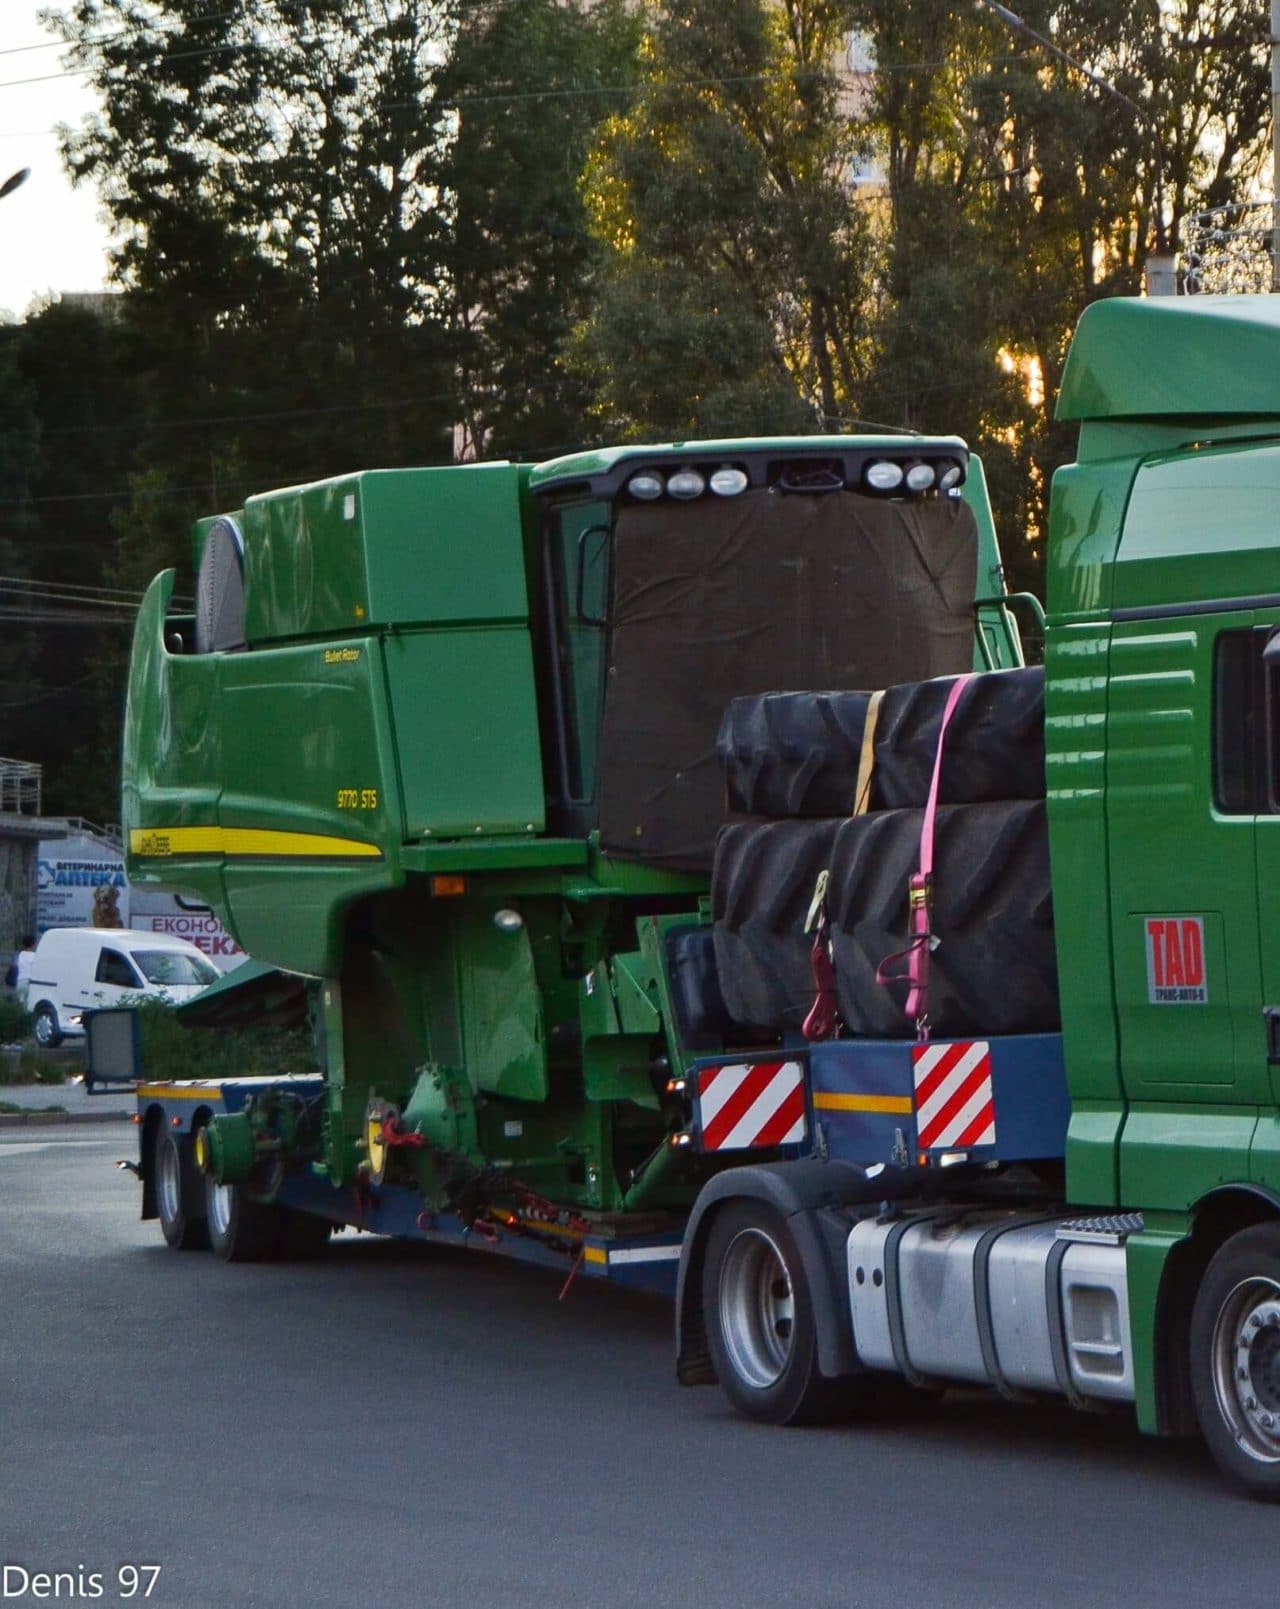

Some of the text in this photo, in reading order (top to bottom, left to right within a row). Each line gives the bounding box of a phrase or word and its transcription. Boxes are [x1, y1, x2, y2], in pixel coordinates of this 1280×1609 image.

[337, 789, 377, 809] 9770 STS
[56, 862, 125, 872] ВЕТЕРИНАРНА
[55, 871, 127, 887] АПТЕКА
[151, 917, 224, 933] ЕКОНО
[1147, 919, 1204, 987] TAD
